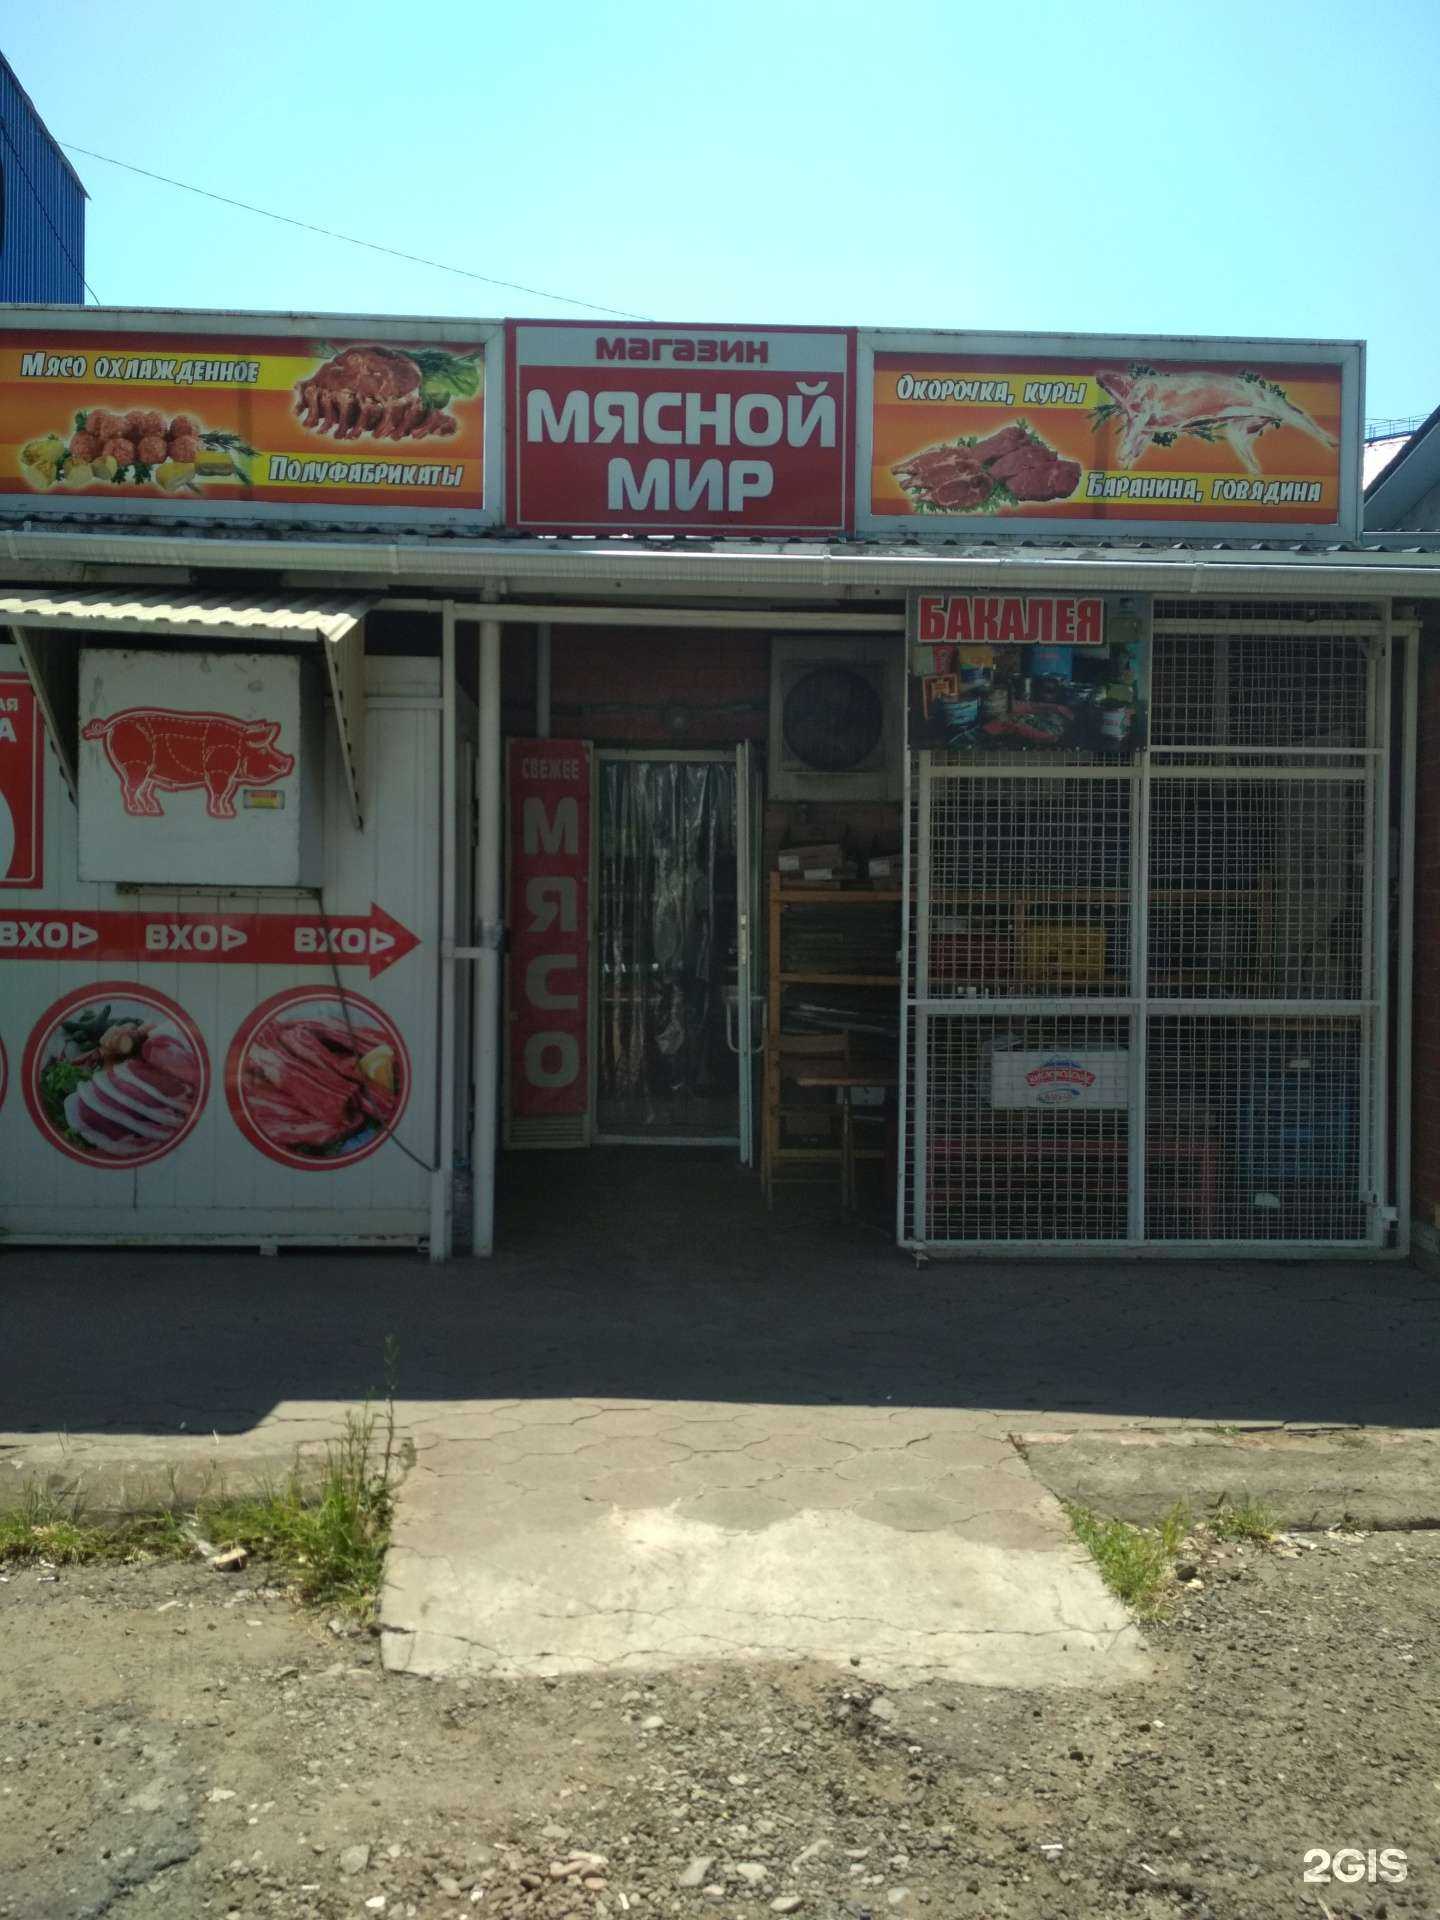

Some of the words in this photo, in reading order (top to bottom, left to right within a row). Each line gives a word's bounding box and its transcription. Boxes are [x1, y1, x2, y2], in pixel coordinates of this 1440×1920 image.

[526, 381, 836, 448] МЯСНОЙ
[607, 457, 774, 512] МИР
[918, 595, 1104, 645] БАКАЛЕЯ
[522, 758, 580, 779] СВЕЖЕЕ
[522, 796, 580, 1088] МЯСО
